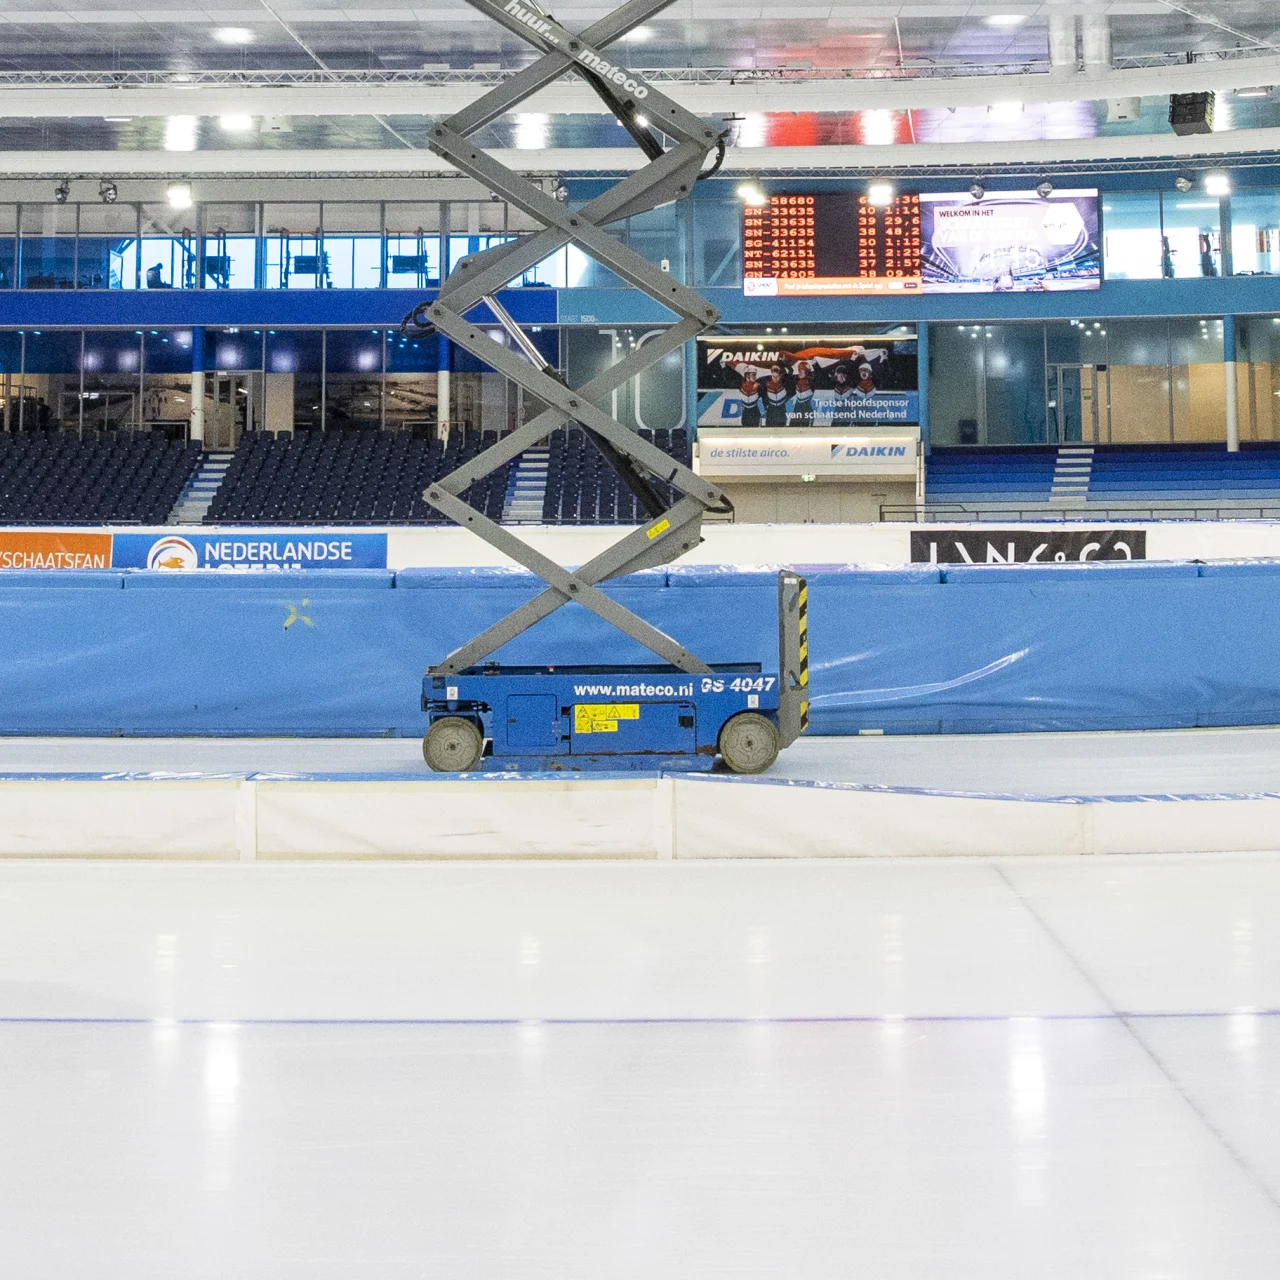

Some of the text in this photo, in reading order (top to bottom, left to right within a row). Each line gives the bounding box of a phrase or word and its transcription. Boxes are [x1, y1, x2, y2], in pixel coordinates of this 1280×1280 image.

[577, 49, 649, 99] mateco
[744, 196, 815, 205] -58680
[744, 208, 815, 216] SN-33635
[858, 207, 876, 215] 40
[858, 217, 876, 225] 39
[744, 229, 815, 237] SN-33635
[858, 228, 876, 236] 38
[744, 239, 815, 247] SG-41154
[858, 238, 876, 246] 50
[744, 250, 815, 258] NT-62151
[859, 249, 876, 257] 21
[859, 259, 877, 267] 37
[721, 351, 780, 362] DAIKIN
[814, 398, 910, 409] Trotse hoofdsponsor
[804, 410, 857, 419] schaatsend
[859, 409, 907, 418] Nederland
[710, 447, 790, 458] de stilste airco.
[846, 446, 906, 457] DAIKIN
[204, 542, 353, 561] NEDERLANDSE
[729, 677, 776, 693] 4047
